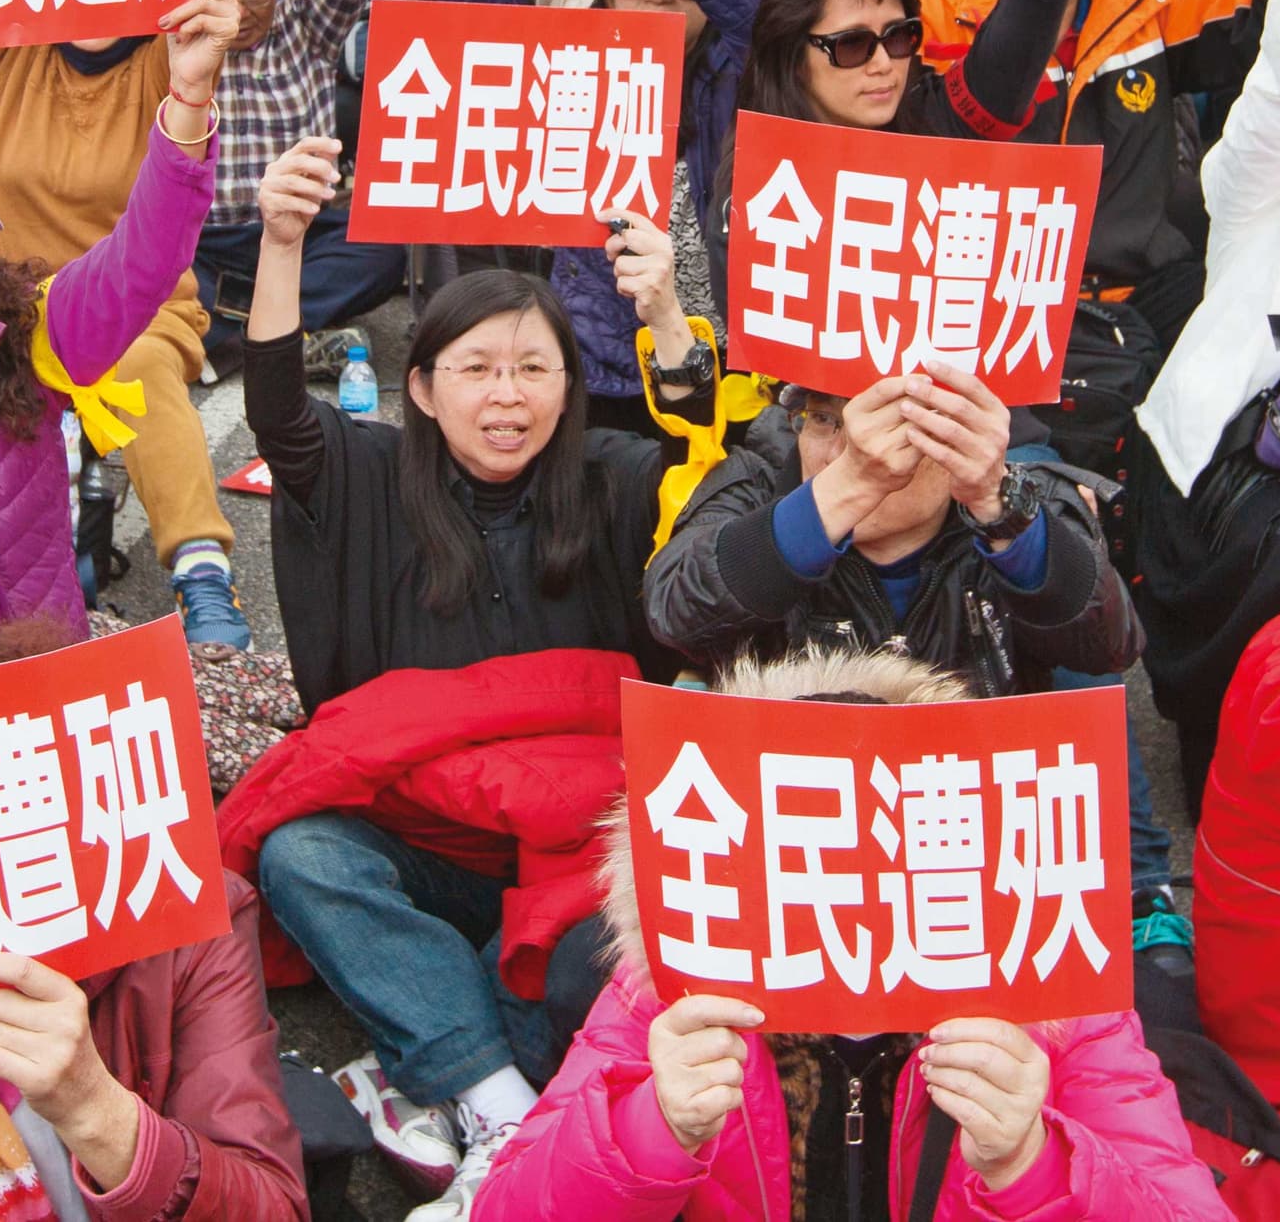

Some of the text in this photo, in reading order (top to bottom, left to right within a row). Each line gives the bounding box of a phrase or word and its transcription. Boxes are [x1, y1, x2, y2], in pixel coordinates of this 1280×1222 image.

[368, 37, 665, 218] 全民遭殃
[745, 159, 1078, 375] 全民遭殃
[644, 741, 1111, 996] 全民遭殃
